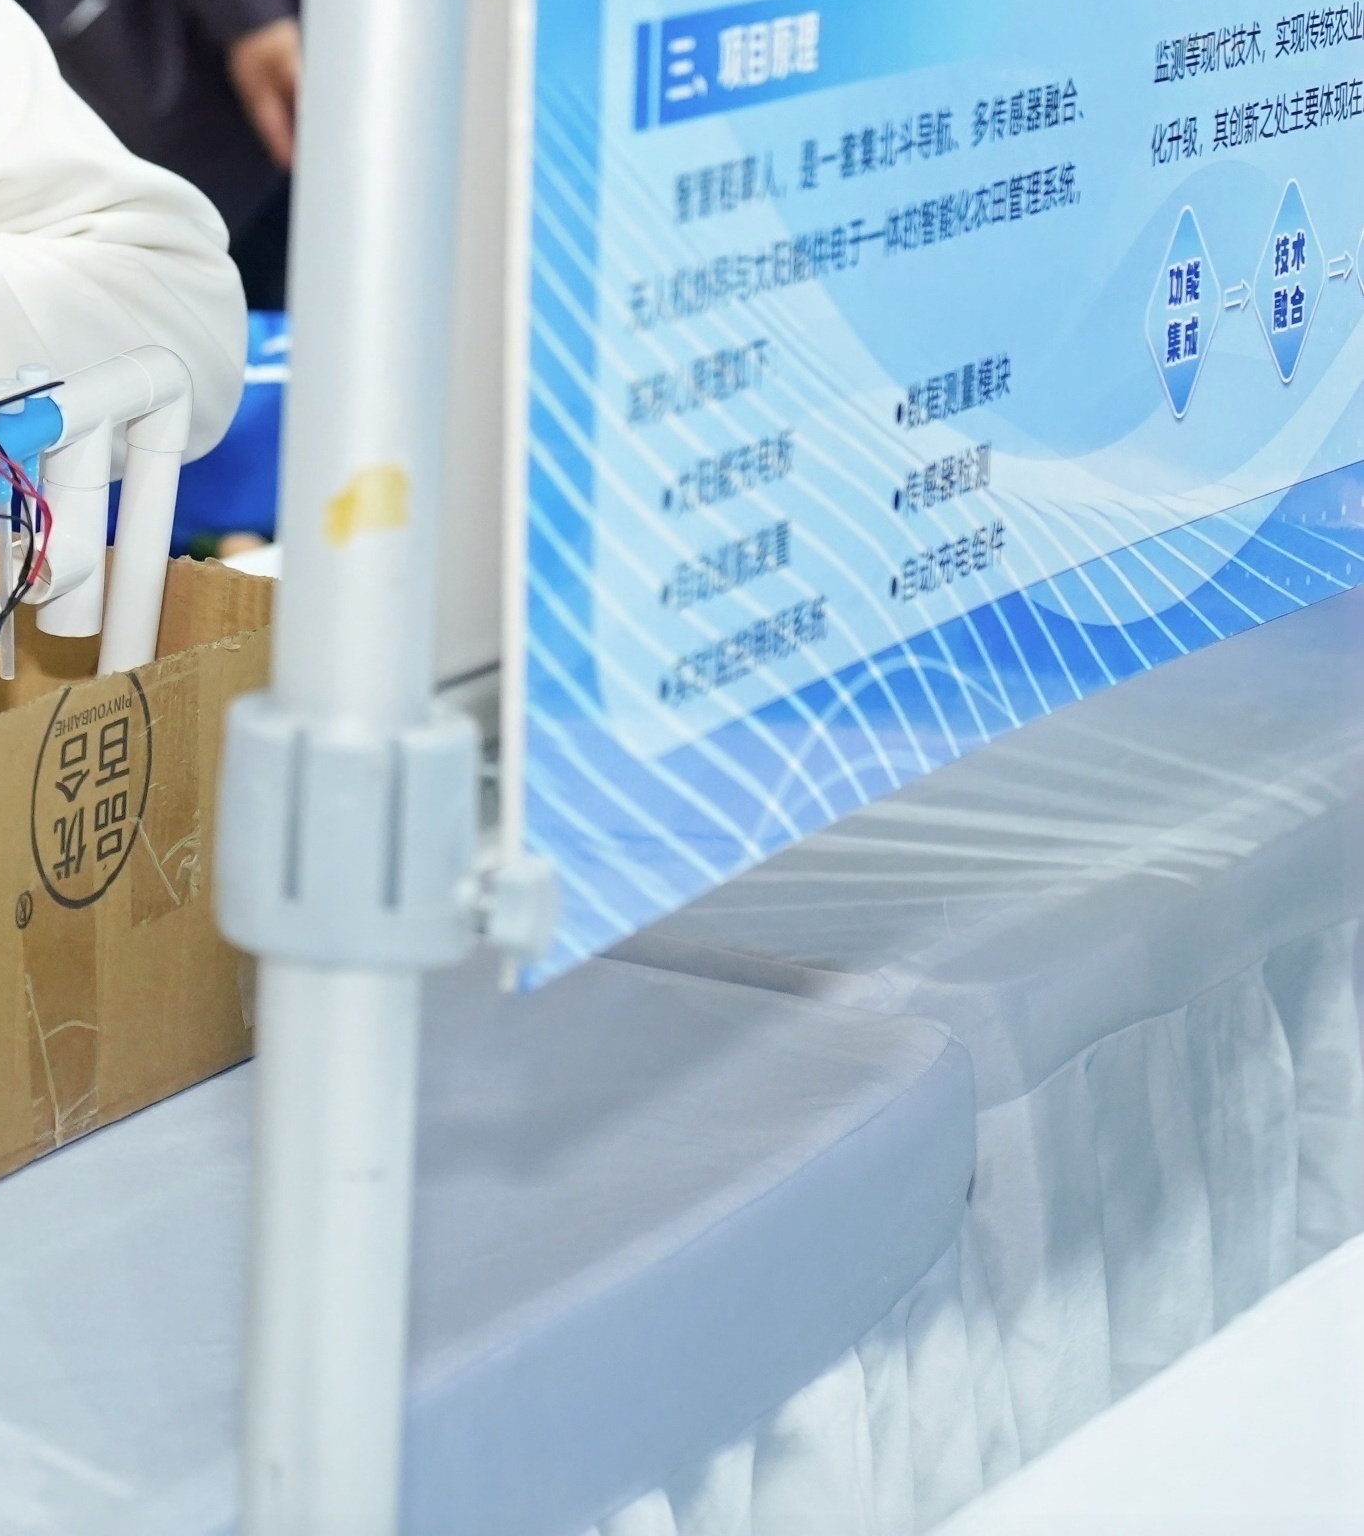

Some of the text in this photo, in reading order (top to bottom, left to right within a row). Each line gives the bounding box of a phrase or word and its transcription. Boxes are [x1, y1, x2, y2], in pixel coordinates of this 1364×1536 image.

[665, 10, 821, 101] 三、项目原理
[1154, 2, 1364, 84] 监测等现代技术，实现传统农业
[1167, 260, 1202, 306] 功能
[1274, 231, 1306, 277] 技术
[1272, 285, 1305, 331] 融合
[1166, 316, 1200, 364] 集成
[906, 352, 1012, 431] 数据测量模块
[905, 441, 992, 518] 传感器检测
[902, 518, 1007, 603] 自动充电组件
[54, 695, 132, 739] PINYOUBAIHE
